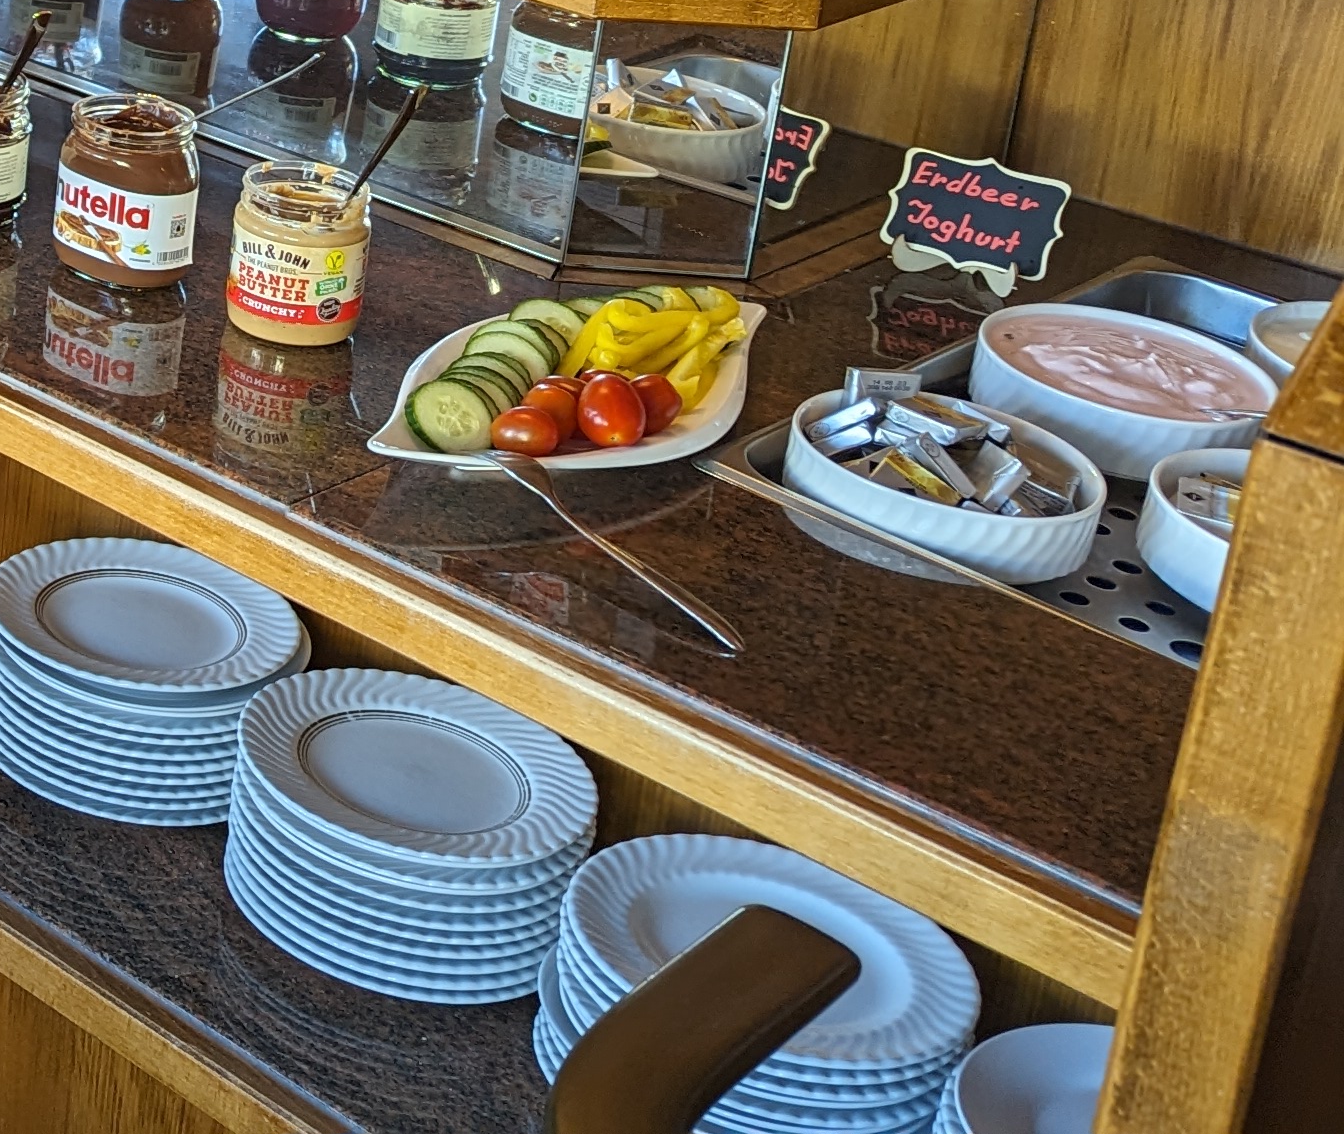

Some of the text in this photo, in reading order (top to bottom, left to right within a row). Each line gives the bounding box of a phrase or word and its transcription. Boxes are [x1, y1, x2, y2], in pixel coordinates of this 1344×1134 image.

[911, 160, 1040, 211] Erdbeer
[56, 176, 151, 230] nutella
[907, 199, 1022, 254] Joghurt
[242, 241, 311, 270] BILL & JOHN
[257, 260, 279, 272] PEANUT
[238, 260, 310, 290] PEANUT
[238, 273, 307, 302] BUTTER
[242, 296, 298, 318] CRUNCHY
